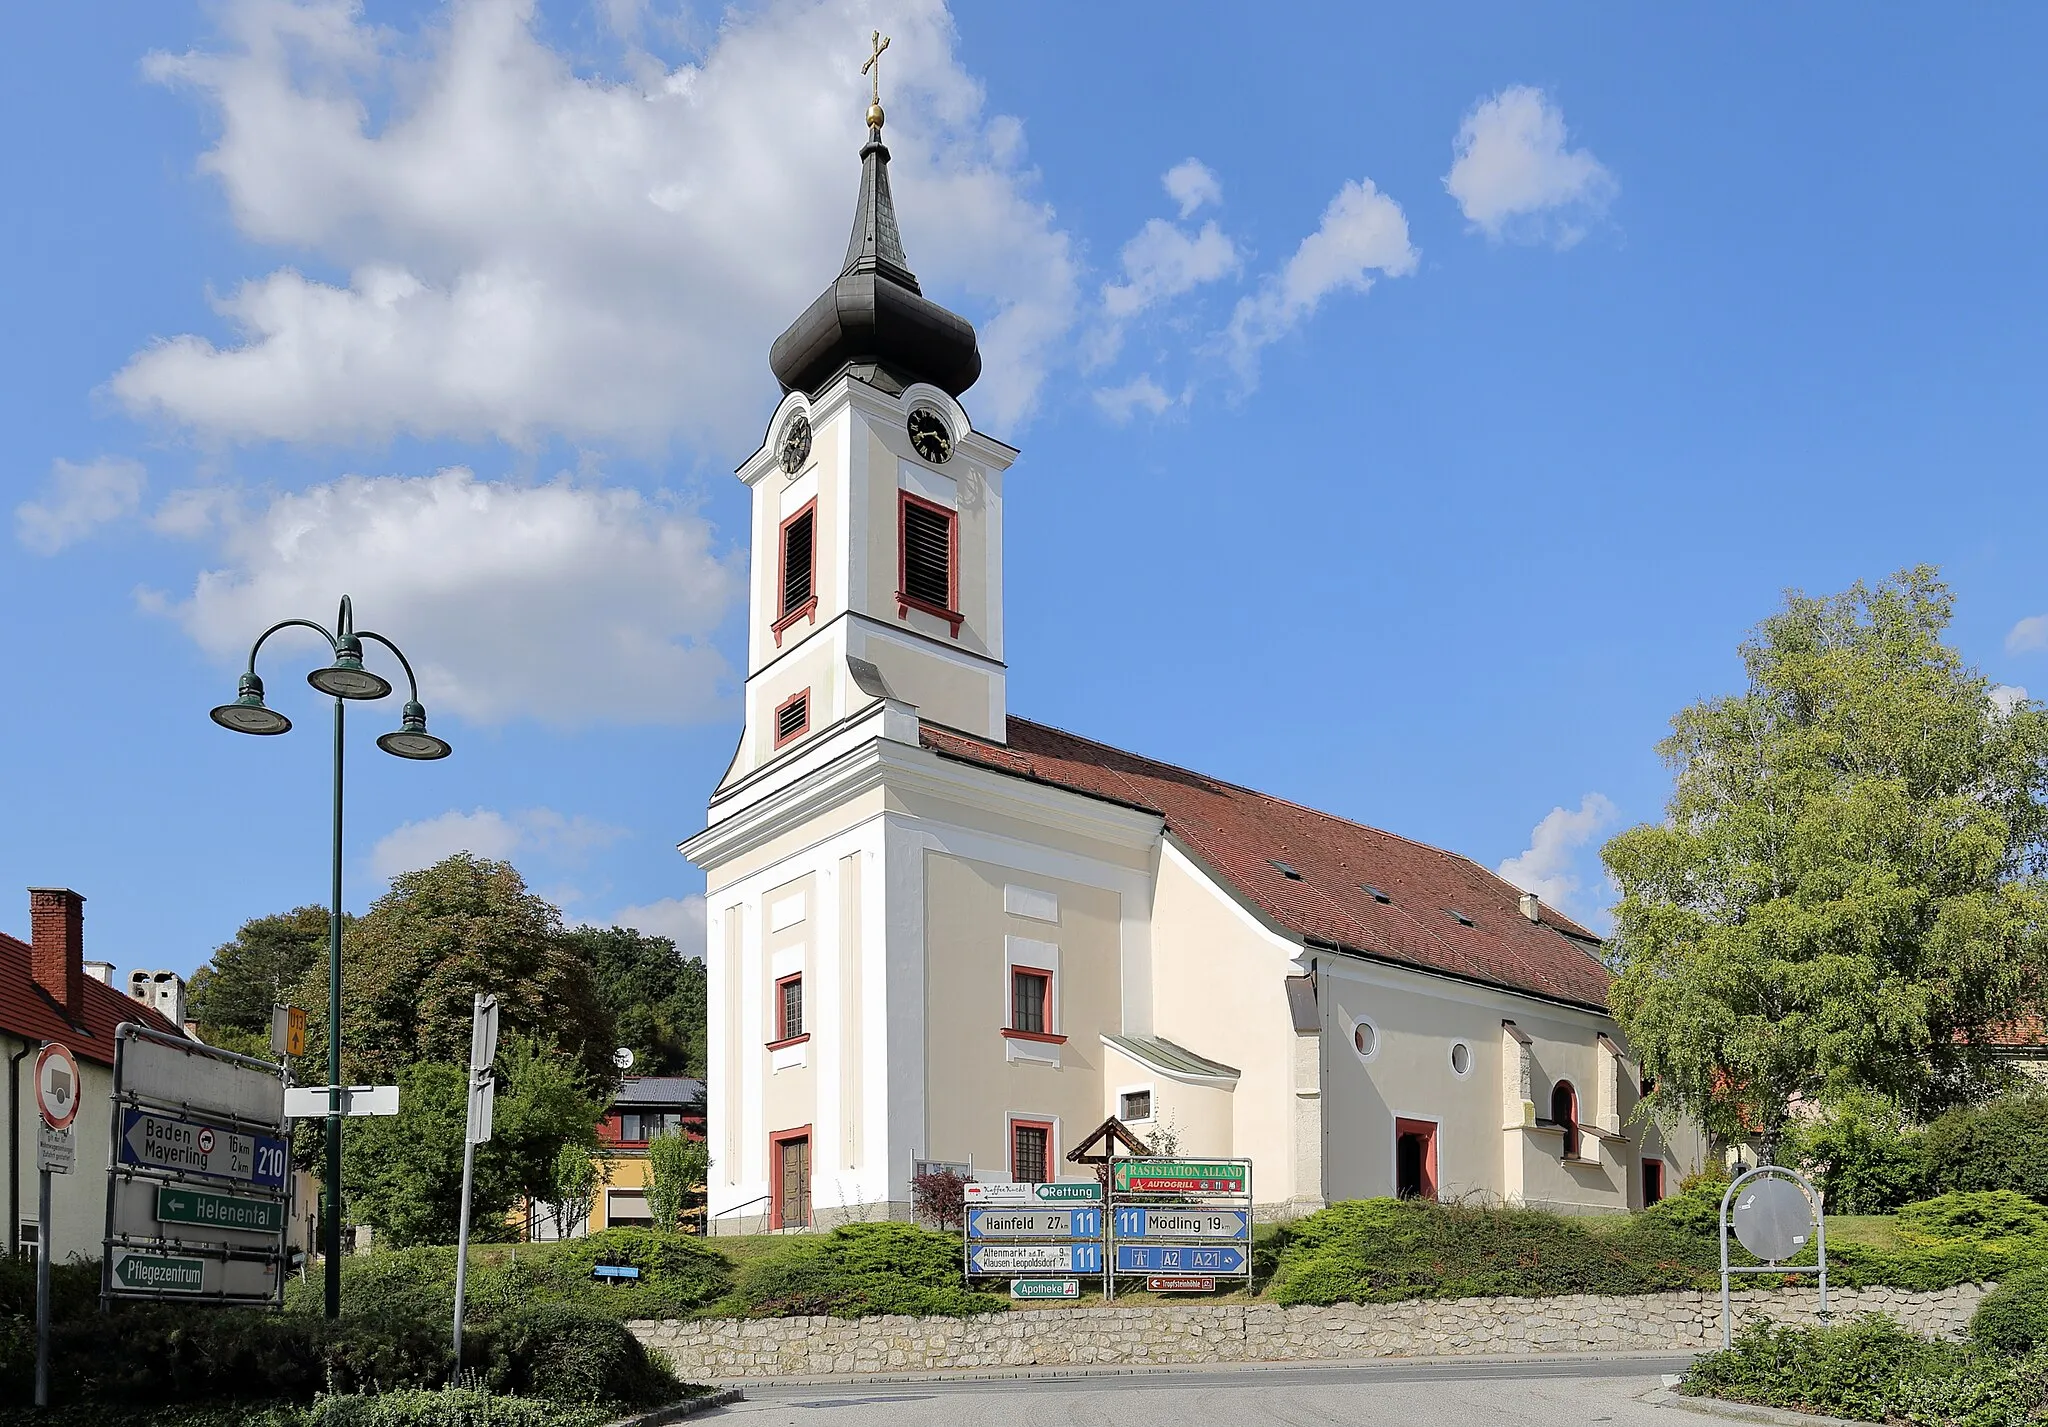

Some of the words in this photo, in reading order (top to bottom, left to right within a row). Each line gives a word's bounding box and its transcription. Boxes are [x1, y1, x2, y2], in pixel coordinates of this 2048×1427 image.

[290, 1012, 303, 1030] U13
[146, 1118, 191, 1144] Baden
[229, 1135, 238, 1152] 16
[238, 1142, 250, 1155] km
[145, 1139, 208, 1171] Mayerling
[231, 1155, 237, 1171] 2
[238, 1161, 249, 1173] km
[258, 1147, 283, 1177] 210
[1130, 1165, 1200, 1176] RASTSTATION
[1201, 1167, 1242, 1177] ALLAND
[1049, 1184, 1093, 1198] Rettung
[197, 1198, 270, 1225] Helenental
[986, 1217, 1034, 1229] Hainfeld
[1048, 1217, 1060, 1229] 27
[1076, 1212, 1094, 1233] 11
[1121, 1212, 1138, 1233] 11
[1149, 1216, 1200, 1232] Mödling
[1207, 1217, 1221, 1230] 19
[984, 1248, 1026, 1257] Altenmarkt
[1059, 1248, 1064, 1257] 9
[1077, 1247, 1094, 1268] 11
[1164, 1252, 1178, 1266] A2
[1194, 1253, 1218, 1266] A21
[128, 1260, 200, 1285] Pflegezentrum
[1021, 1284, 1062, 1295] Apotheke
[1162, 1280, 1200, 1288] Tropfsteinhöhle
